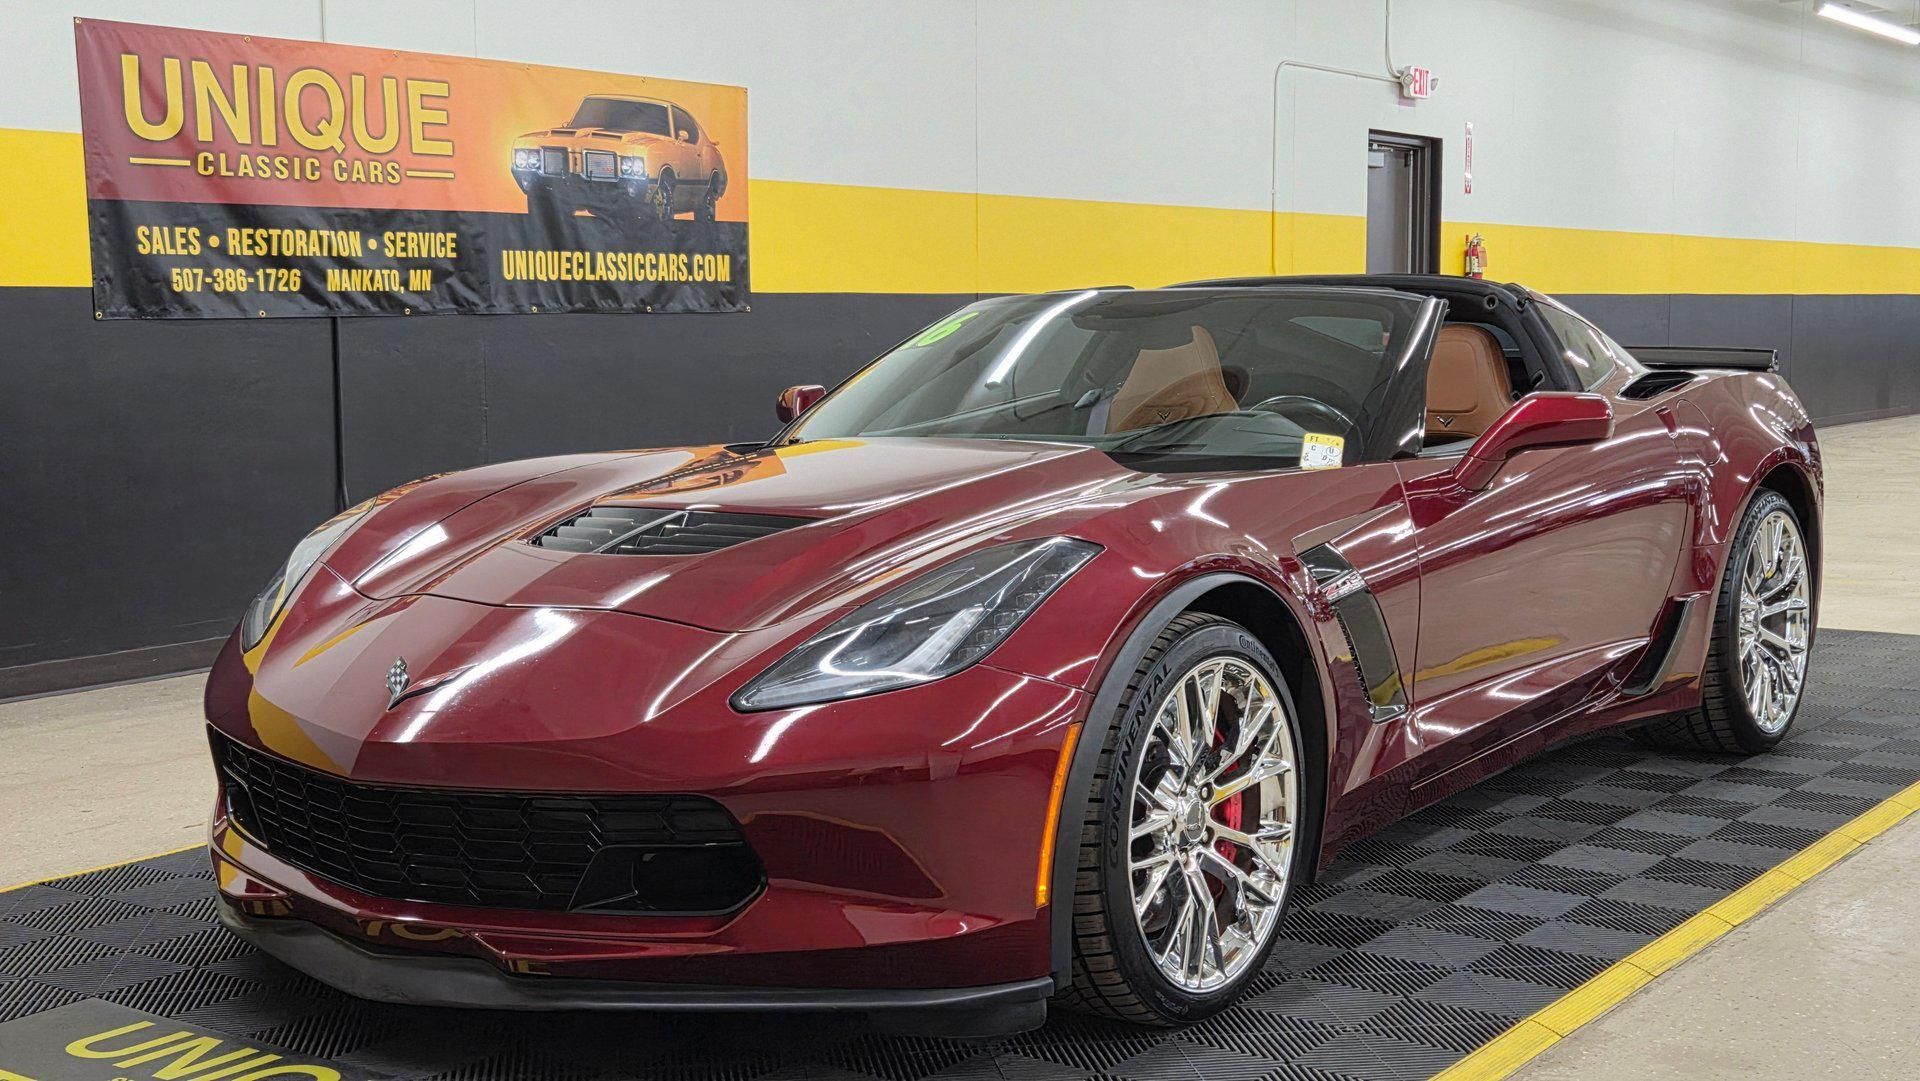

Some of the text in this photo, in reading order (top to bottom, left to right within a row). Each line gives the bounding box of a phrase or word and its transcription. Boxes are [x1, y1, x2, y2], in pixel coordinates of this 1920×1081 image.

[1413, 68, 1429, 96] EXIT
[121, 54, 455, 156] UNIQUE
[197, 151, 401, 184] CLASSIC CARS
[137, 226, 457, 258] SALES RESTORATION SERVICE
[171, 268, 432, 294] 507-386-1726 MANKATO, MN
[502, 250, 731, 282] UNIQUECLASSICCARS.COM
[1108, 662, 1173, 868] CONTINENTAL
